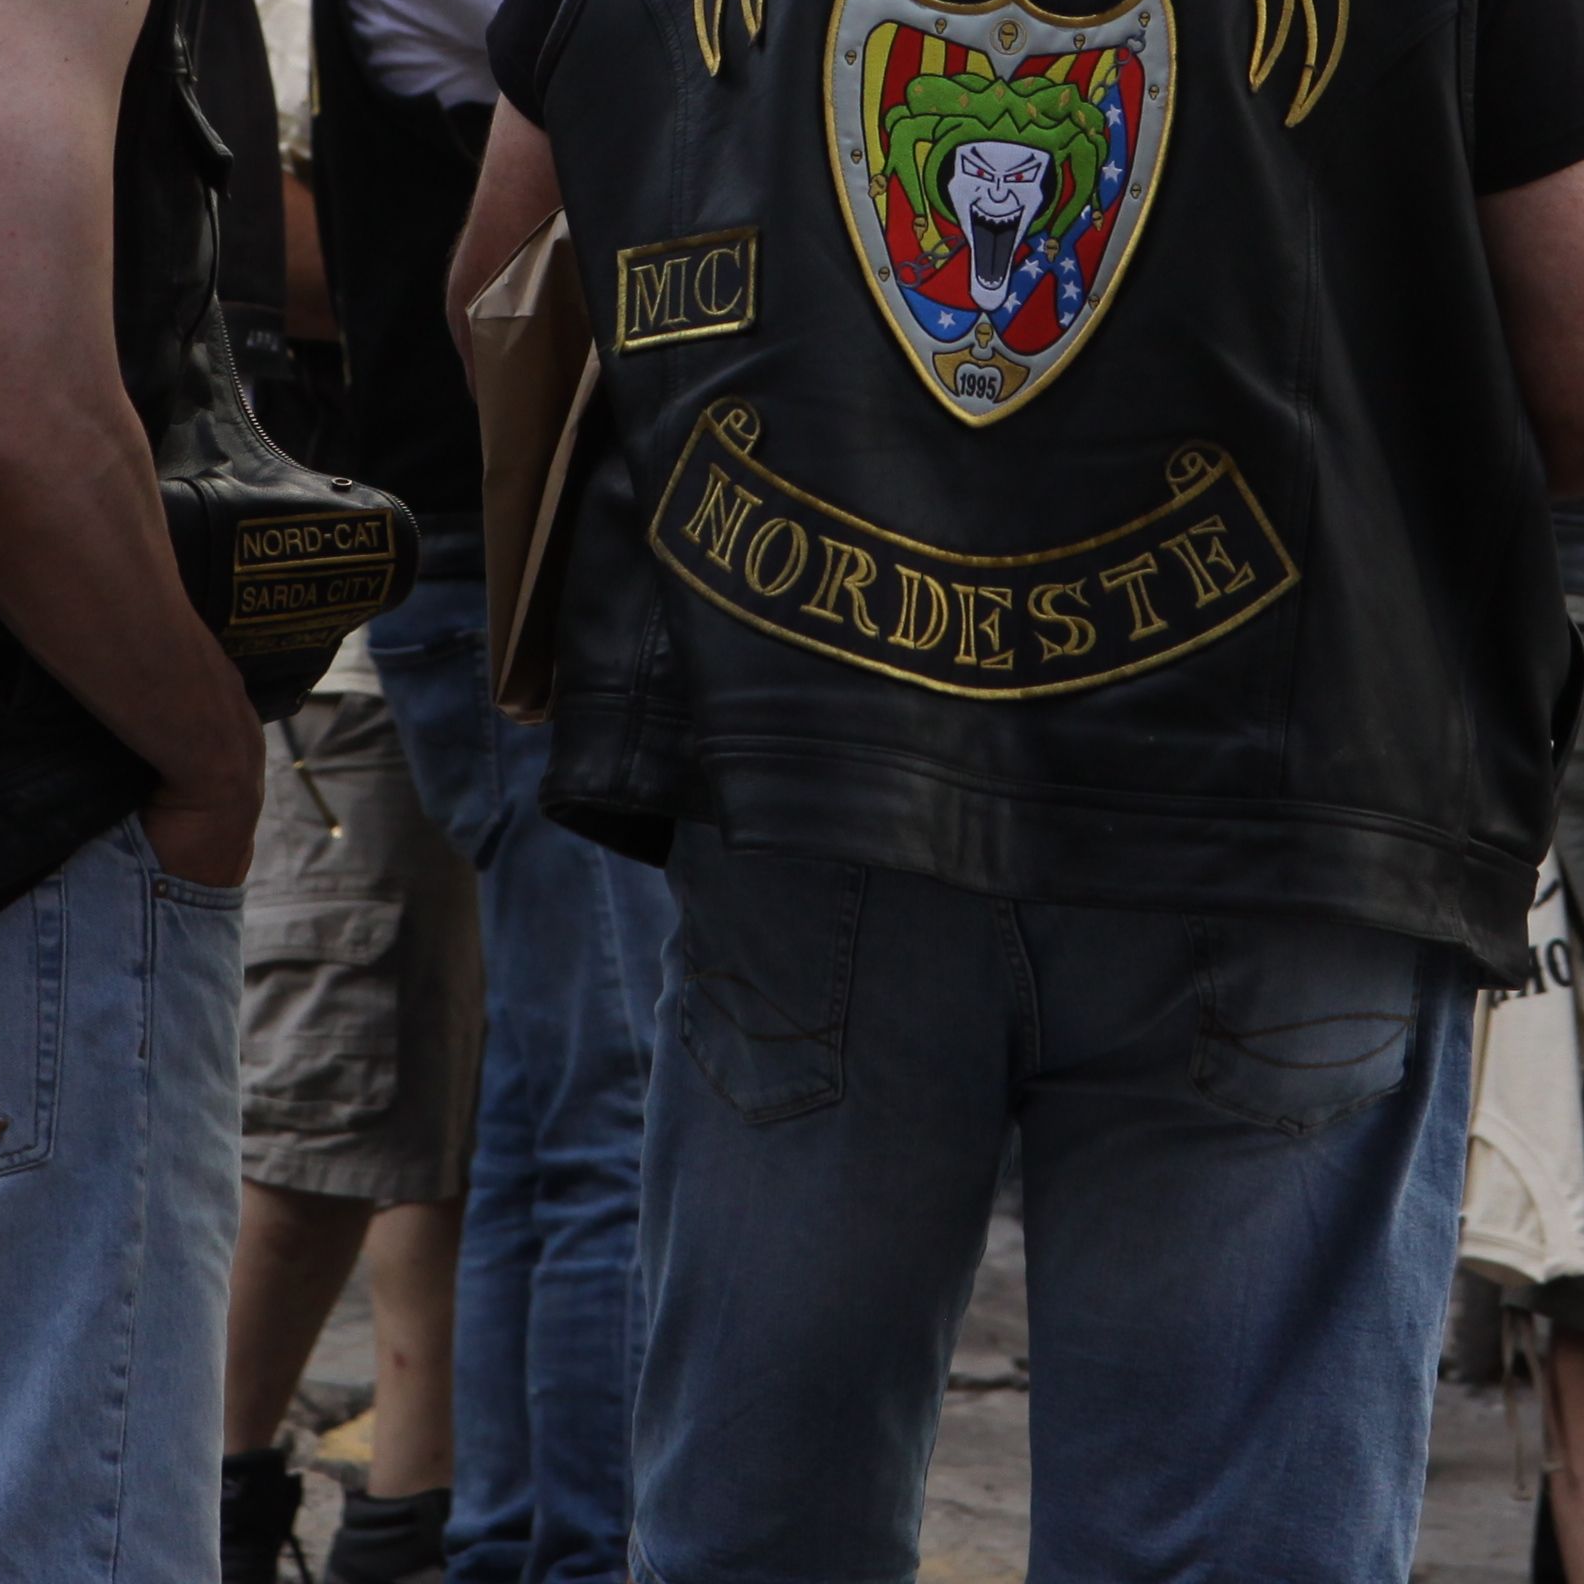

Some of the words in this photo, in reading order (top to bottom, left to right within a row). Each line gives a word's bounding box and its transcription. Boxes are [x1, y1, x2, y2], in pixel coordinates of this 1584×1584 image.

[628, 242, 745, 333] MC
[959, 372, 998, 401] 1995
[242, 521, 382, 560] NORD-CAT
[679, 462, 1257, 671] NORDESTE
[241, 582, 317, 613] SARDA
[327, 576, 383, 602] CITY
